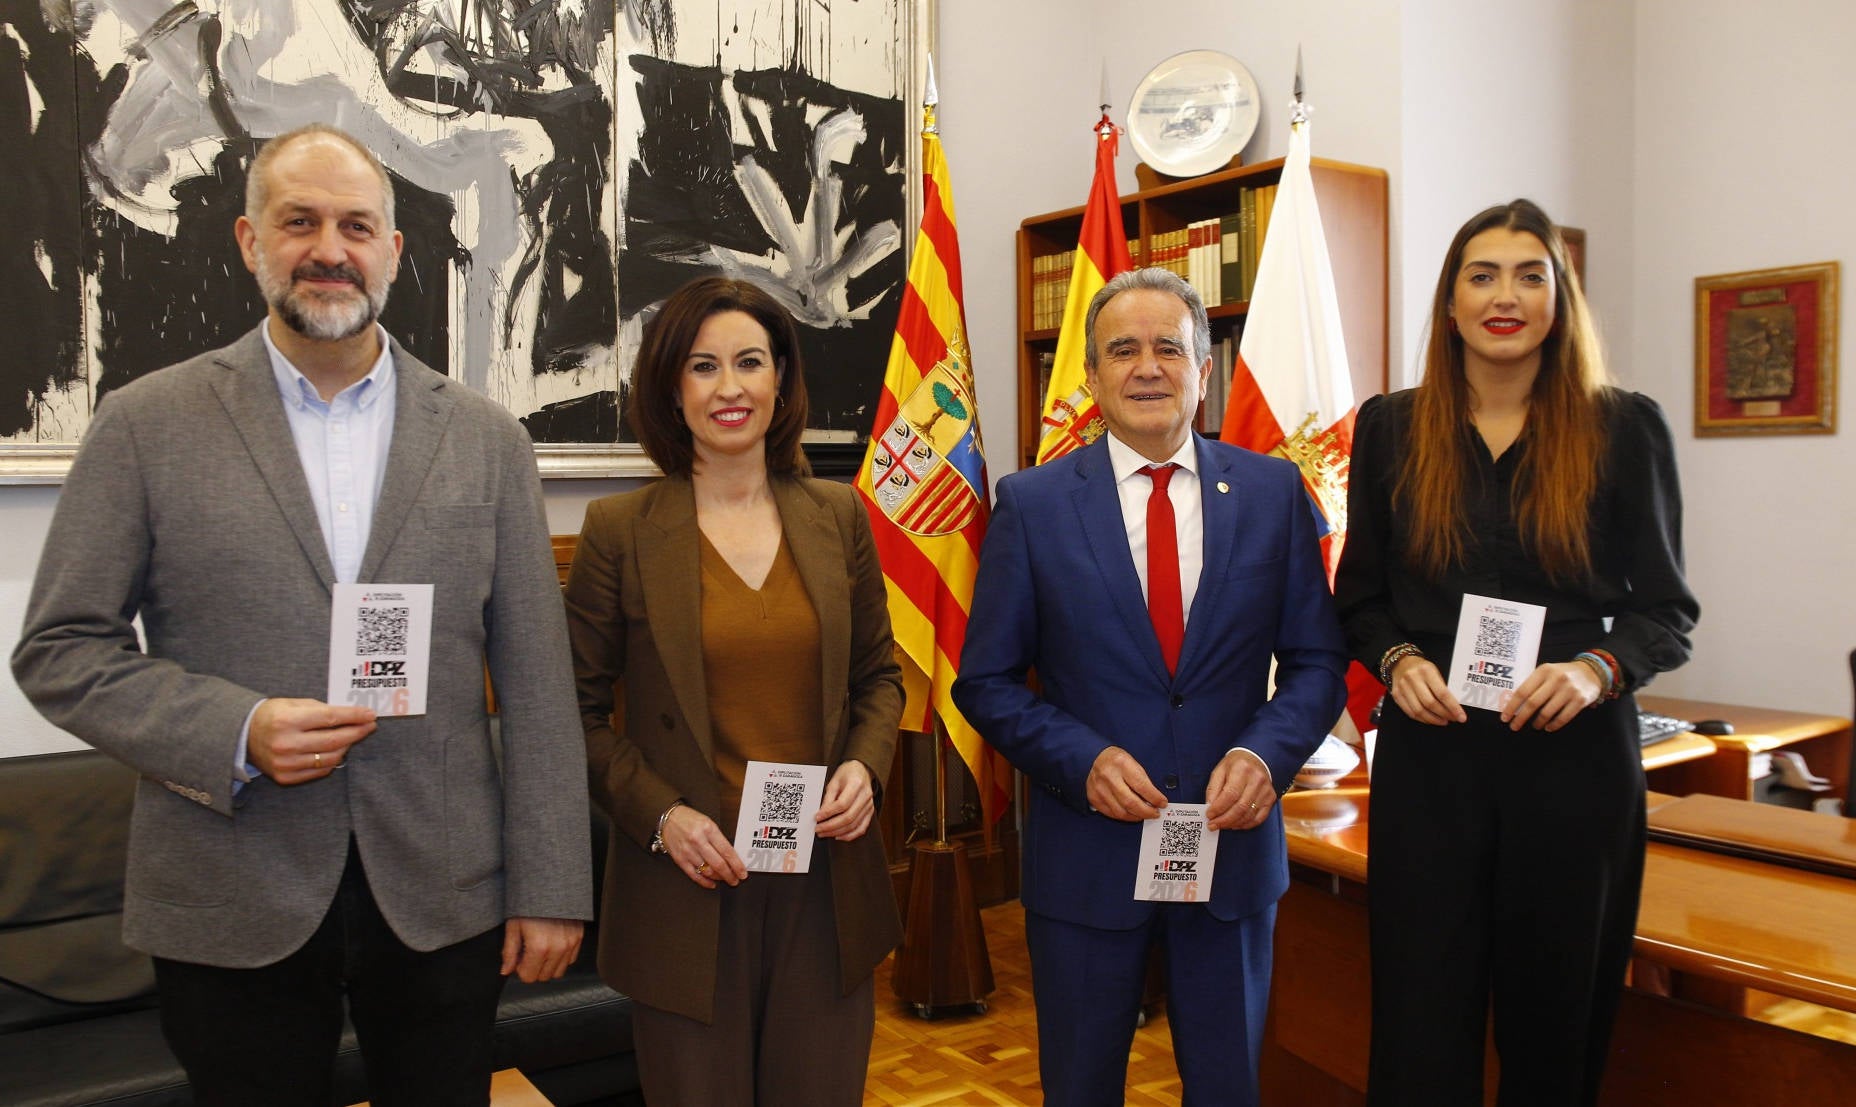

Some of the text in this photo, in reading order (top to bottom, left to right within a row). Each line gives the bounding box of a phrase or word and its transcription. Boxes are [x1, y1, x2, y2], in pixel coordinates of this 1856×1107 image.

[351, 677, 407, 688] PRESUPUESTO
[1467, 673, 1514, 689] PRESUPUESTO
[752, 839, 797, 849] PRESUPUESTO
[1153, 872, 1197, 881] PRESUPUESTO
